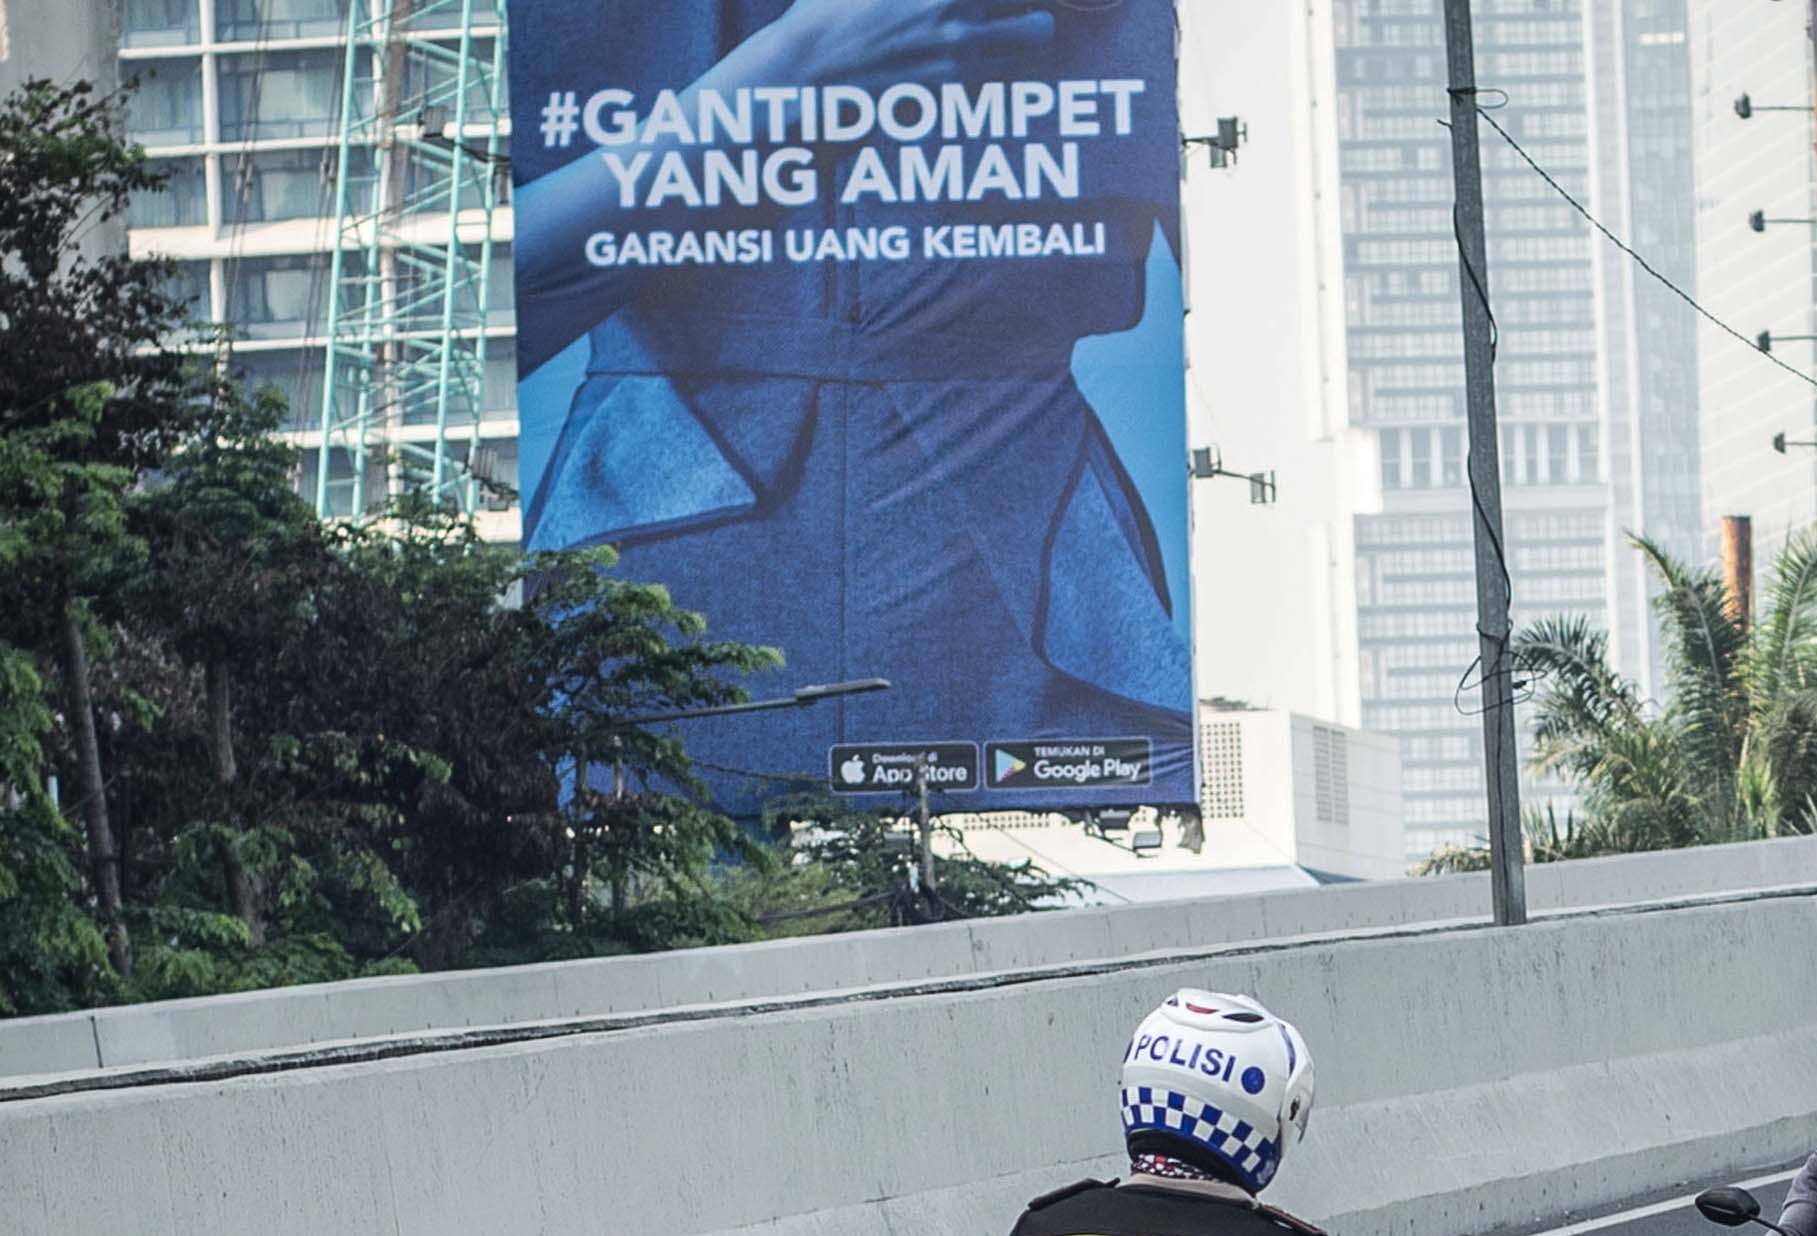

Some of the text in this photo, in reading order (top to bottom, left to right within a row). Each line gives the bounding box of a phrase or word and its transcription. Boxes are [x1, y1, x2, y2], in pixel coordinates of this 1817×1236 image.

[540, 80, 1145, 148] #GANTIDOMPET
[602, 142, 1080, 209] YANG AMAN
[585, 222, 1105, 266] GARANSI UANG KEMBALI
[1034, 745, 1105, 757] TEMUKAN DI
[1034, 758, 1141, 782] Google Play
[872, 765, 912, 783] App
[1134, 1034, 1236, 1082] POLISI
